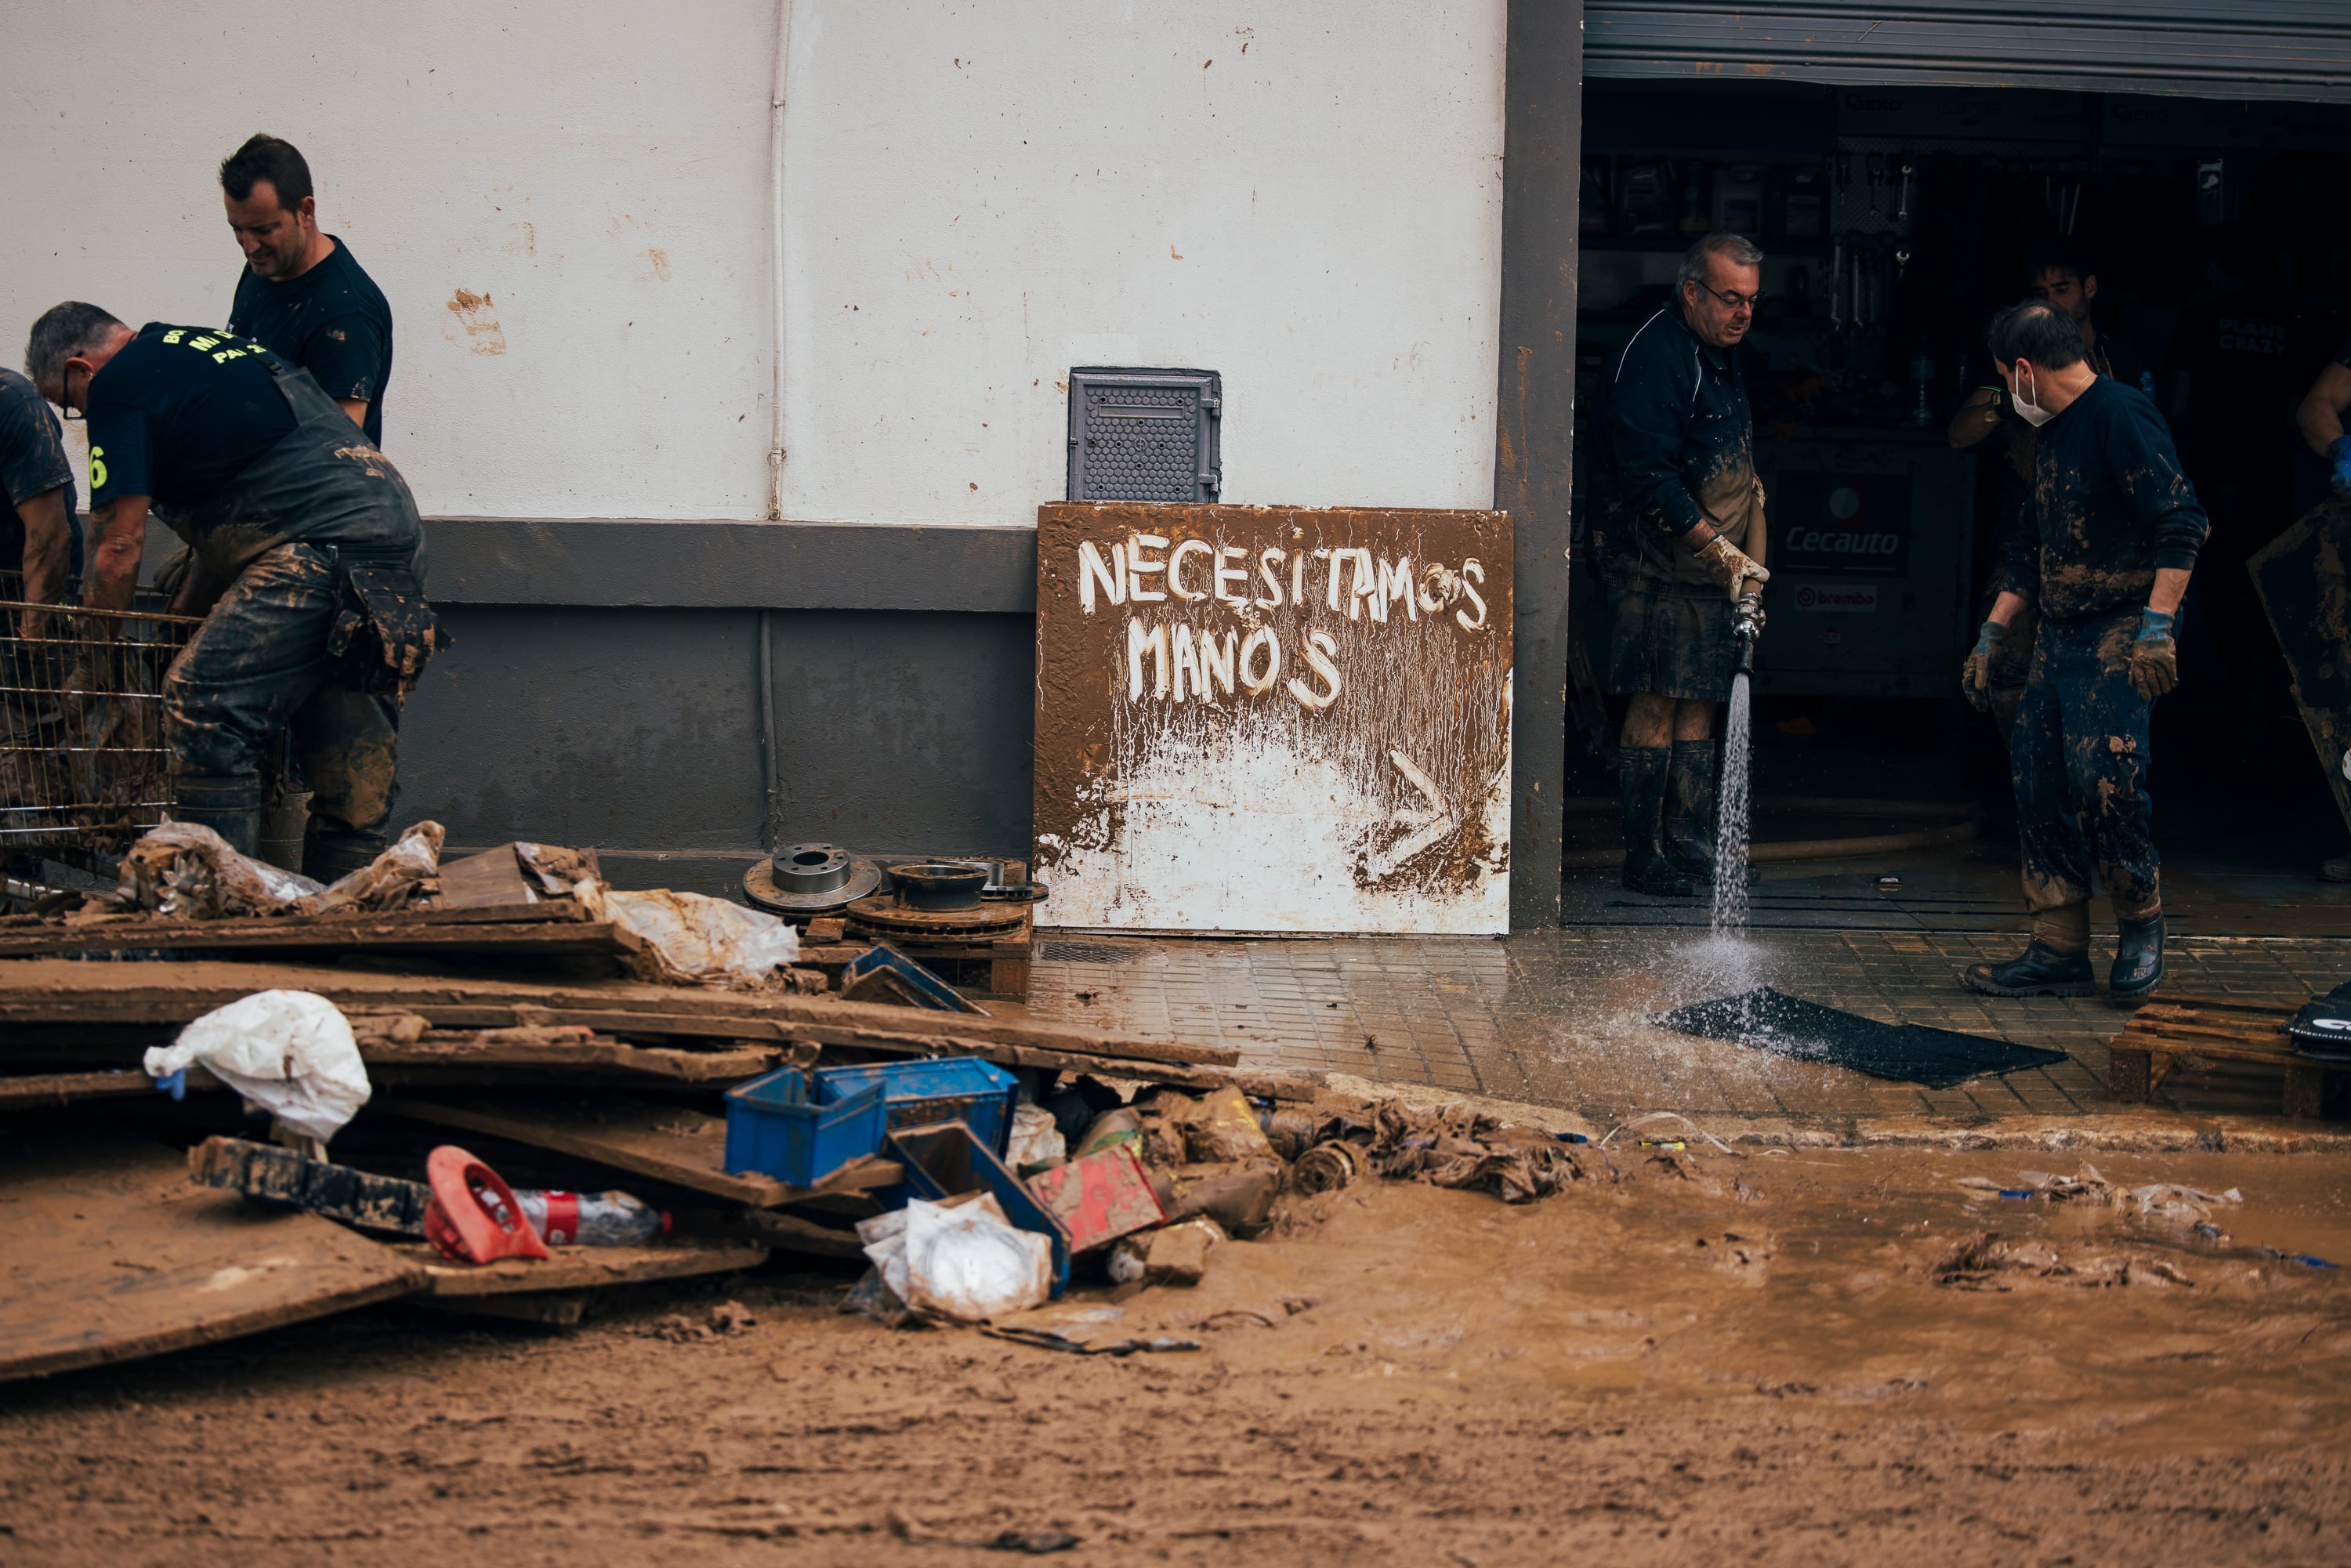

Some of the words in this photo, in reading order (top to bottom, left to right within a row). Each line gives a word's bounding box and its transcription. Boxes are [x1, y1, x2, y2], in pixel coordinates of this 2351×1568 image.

[2219, 318, 2287, 340] PLANE
[2219, 335, 2286, 357] CRAZY
[1785, 527, 1899, 555] Cecauto
[1078, 534, 1488, 632] NECESITAMOS
[1128, 617, 1342, 709] MANOS
